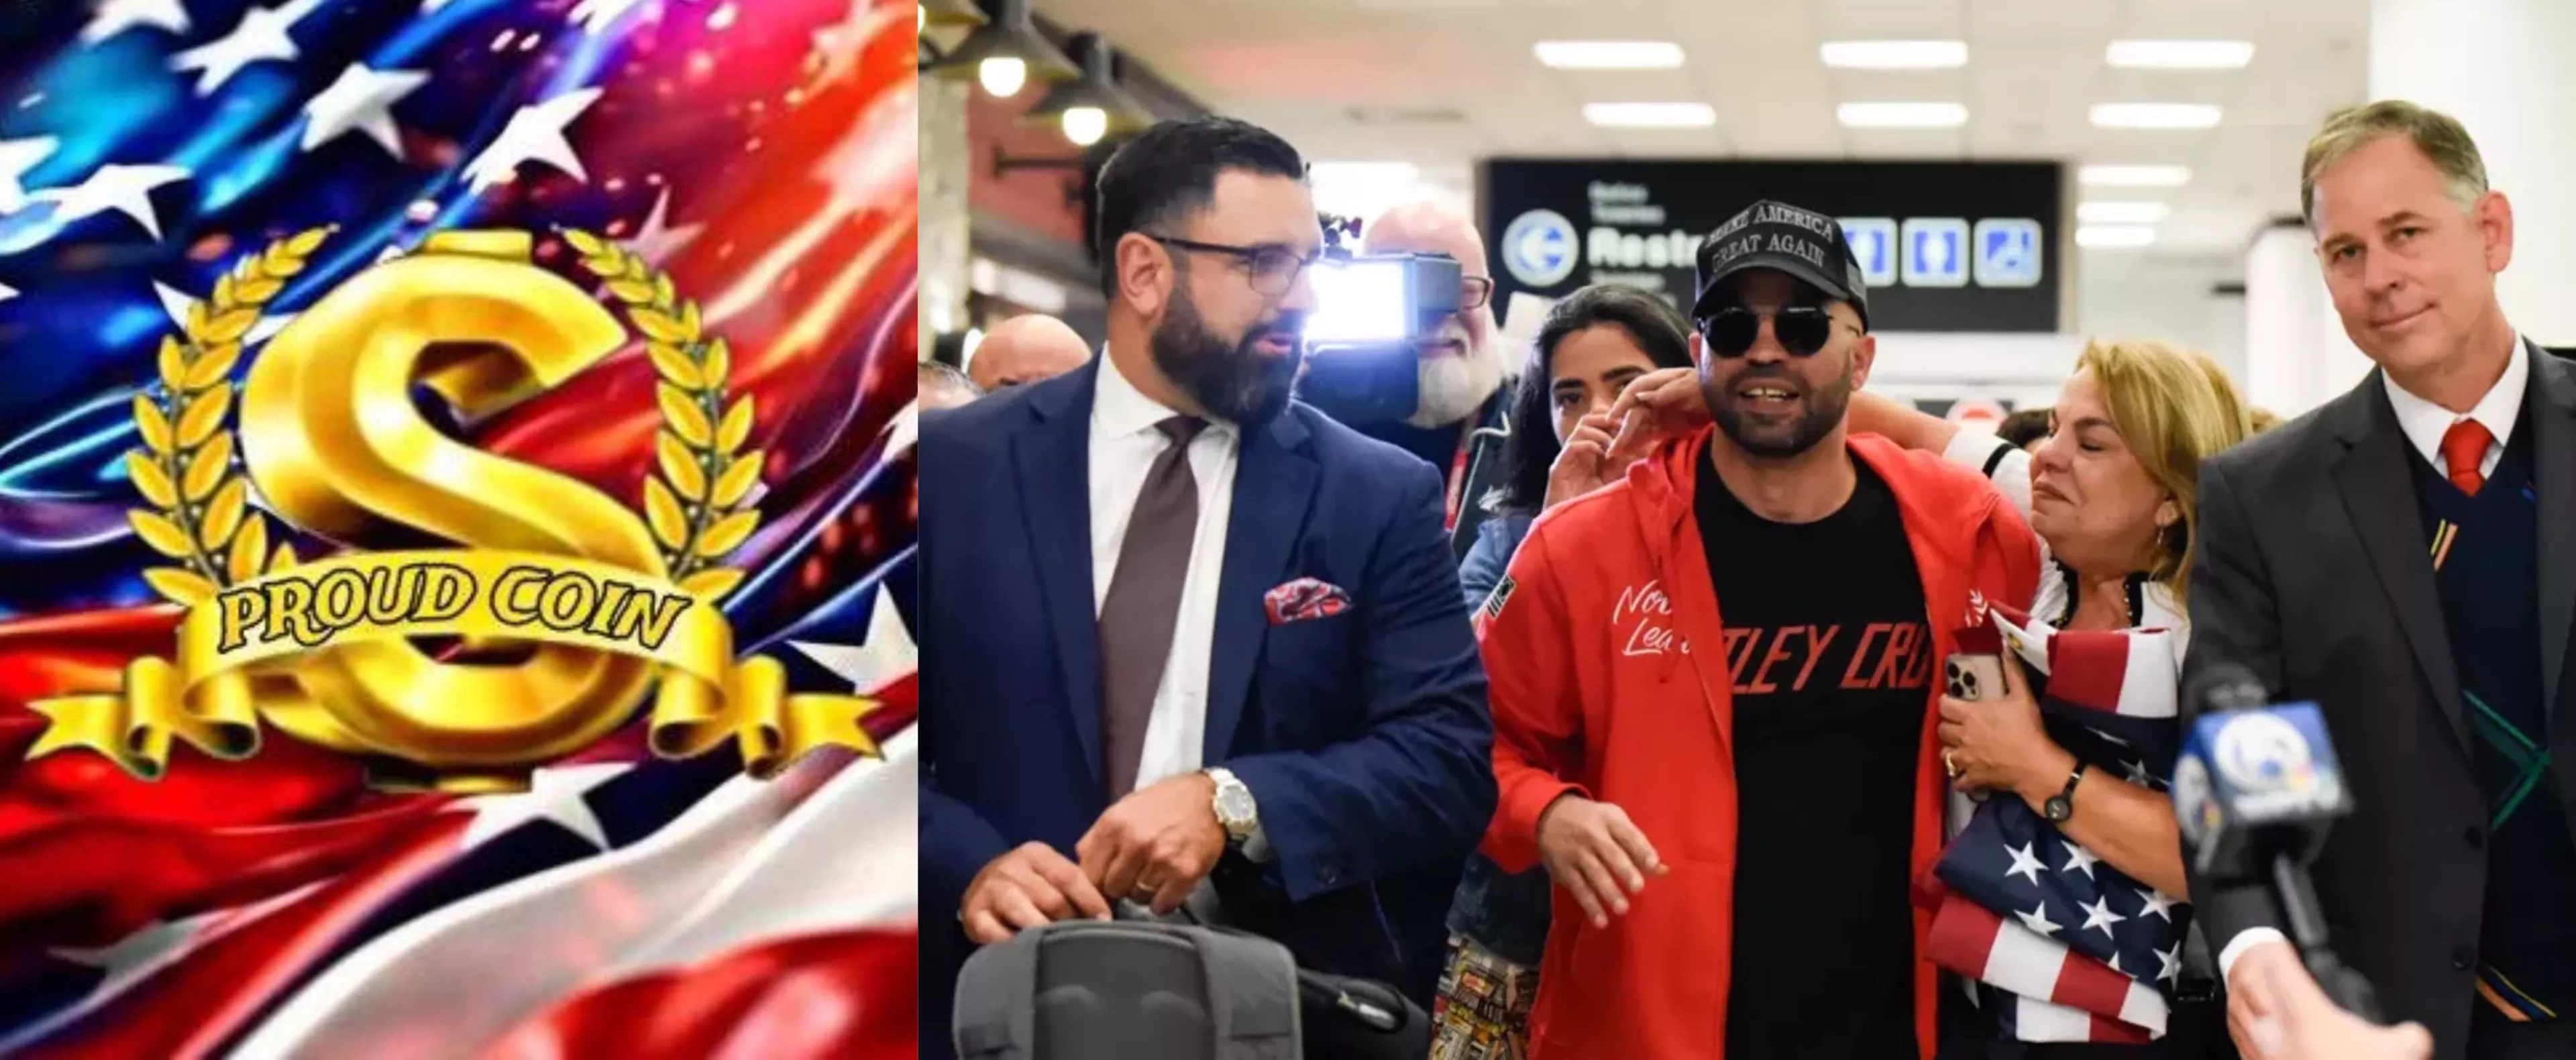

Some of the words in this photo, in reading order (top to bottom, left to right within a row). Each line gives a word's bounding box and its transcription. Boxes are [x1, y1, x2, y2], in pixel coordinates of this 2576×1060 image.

[1754, 205, 1833, 244] AMERICA
[1711, 234, 1762, 273] GREAT
[1767, 233, 1825, 268] AGAIN
[217, 562, 477, 653] PROUD
[490, 565, 694, 649] COIN
[1723, 625, 1841, 694] TLEY
[1839, 621, 1931, 688] CRU
